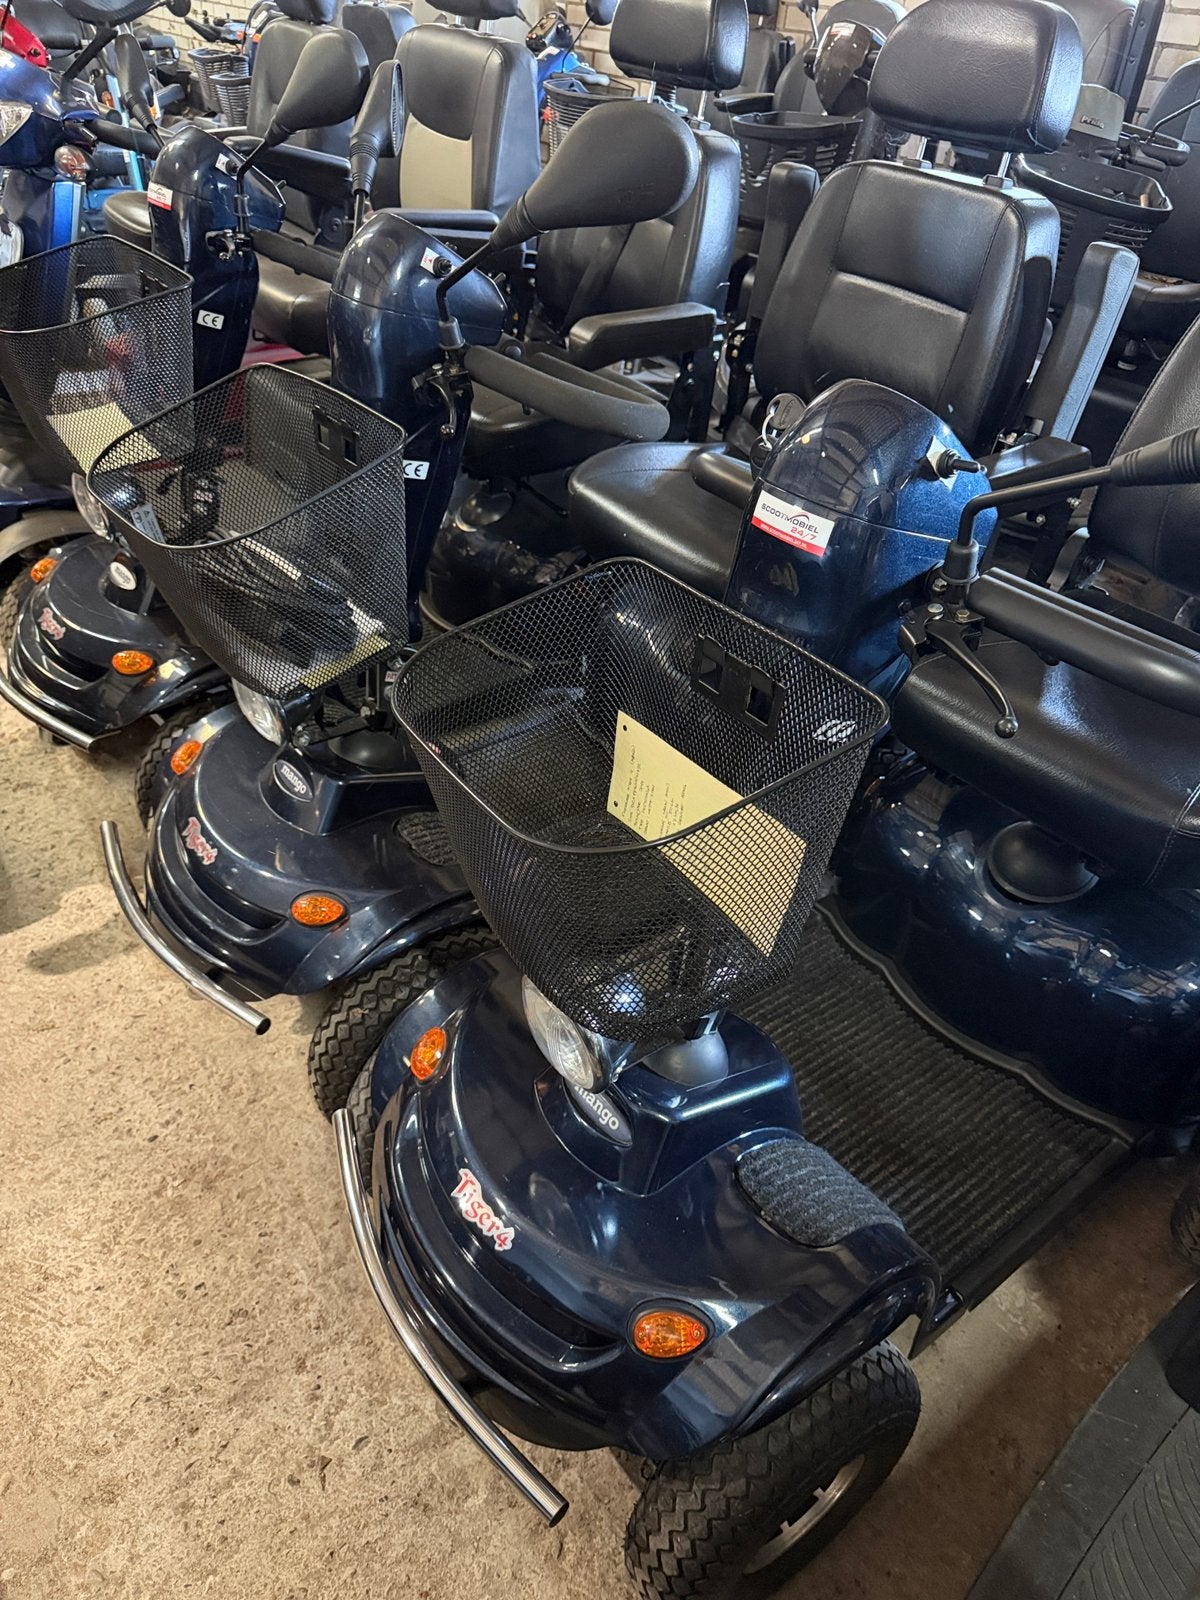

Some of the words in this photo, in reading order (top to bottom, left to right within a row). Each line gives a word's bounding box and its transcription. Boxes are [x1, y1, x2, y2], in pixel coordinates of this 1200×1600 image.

[203, 313, 219, 327] CE
[403, 462, 424, 477] CE
[761, 502, 819, 534] SCOOTMOBIEL
[790, 526, 817, 541] 24/7
[281, 764, 307, 794] mango
